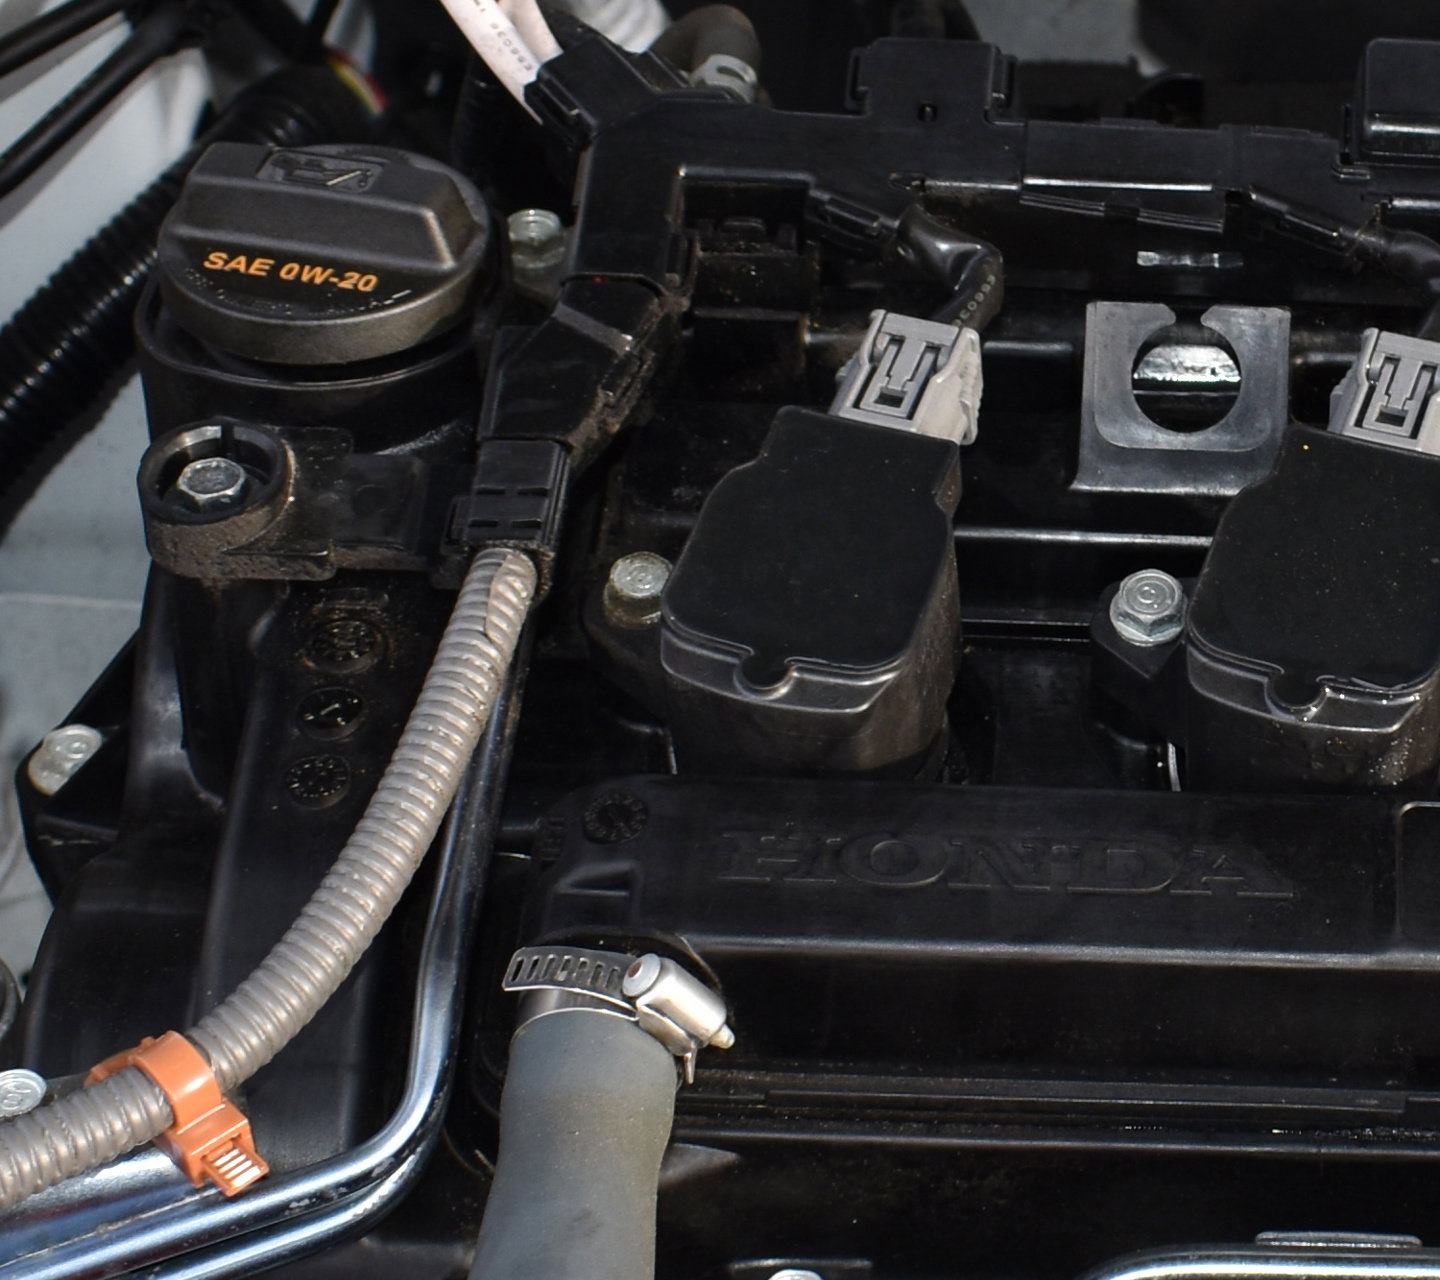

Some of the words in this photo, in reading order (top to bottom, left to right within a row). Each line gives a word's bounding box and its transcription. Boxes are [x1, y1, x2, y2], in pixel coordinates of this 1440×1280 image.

[203, 251, 275, 277] SAE
[279, 262, 379, 293] 0W-20
[715, 827, 1295, 900] HONDA
